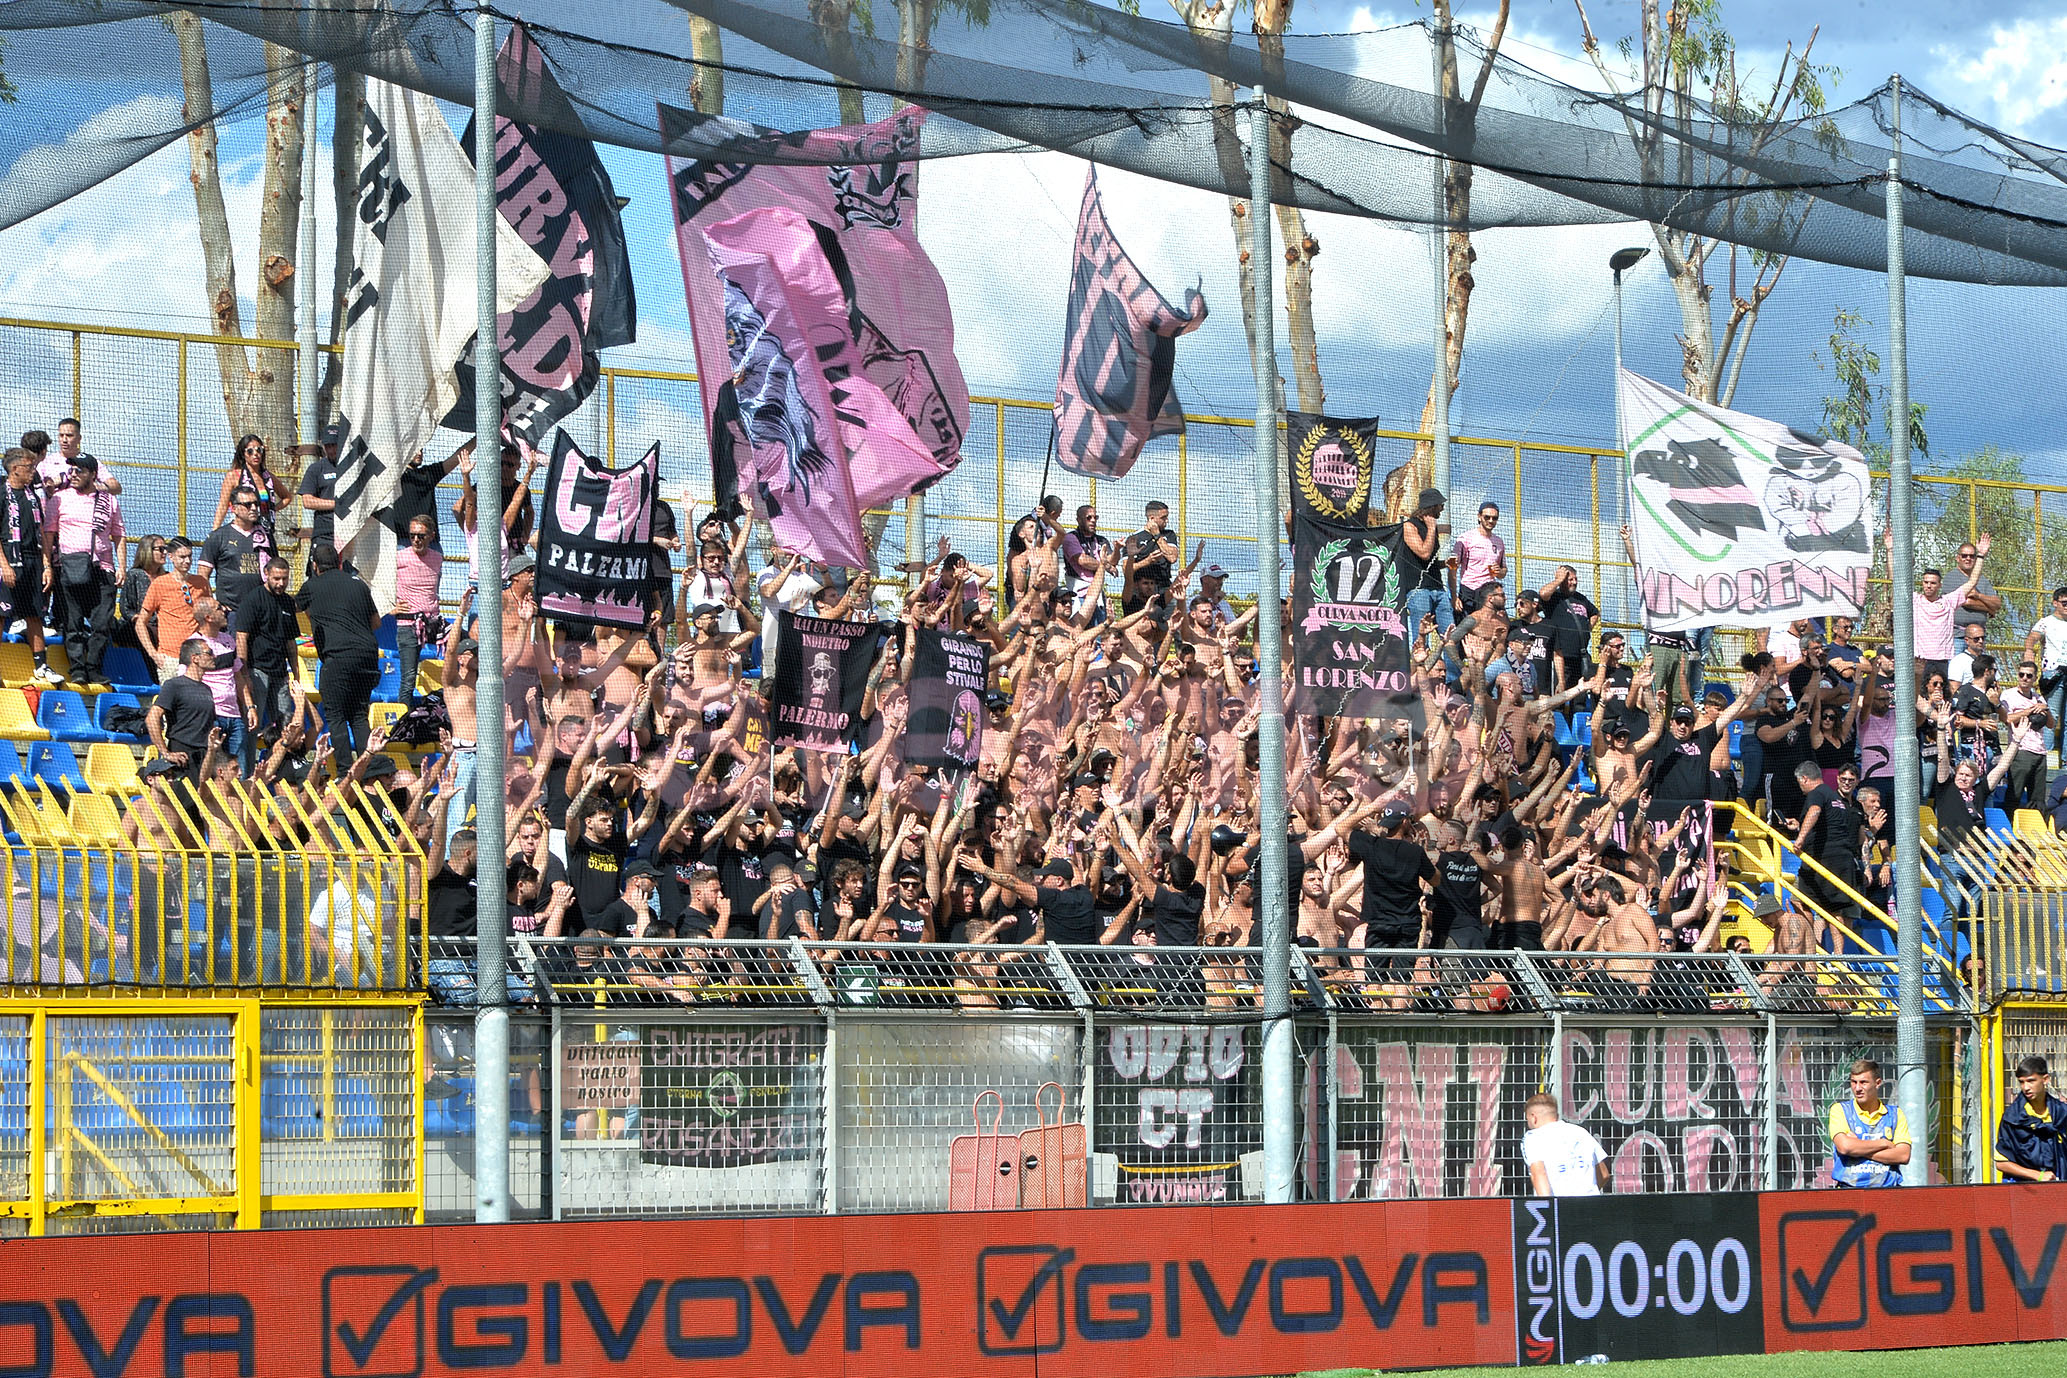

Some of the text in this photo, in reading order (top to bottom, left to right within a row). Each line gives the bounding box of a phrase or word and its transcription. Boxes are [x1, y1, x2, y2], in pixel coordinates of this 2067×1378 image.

[240, 560, 259, 568] WILD
[240, 566, 260, 574] WEST
[241, 553, 257, 561] OLD
[549, 543, 648, 580] PALERMO
[1336, 555, 1381, 603] 12
[1635, 559, 1870, 616] MINORENNI
[793, 616, 866, 637] MAI UN PASSO
[1318, 606, 1393, 622] CURVA NORD
[802, 634, 850, 651] INDIETRO
[941, 637, 983, 659] GIRANDO
[1332, 640, 1375, 662] SAN
[949, 655, 982, 674] PER LO
[1303, 667, 1407, 691] LORENZO
[946, 671, 985, 690] STIVALE
[779, 704, 850, 730] PALERMO
[650, 1026, 800, 1068] EMIGRATI
[1109, 1026, 1245, 1081] ODIO
[1561, 1027, 1815, 1124] CURVA
[578, 1085, 631, 1099] nostro
[667, 1088, 703, 1099] ETERNA
[1140, 1088, 1214, 1149] CT
[642, 1115, 807, 1157] ROSANERO
[1595, 1122, 1803, 1193] ORD
[1525, 1200, 1553, 1342] NGM
[1563, 1238, 1751, 1319] 00:00
[1876, 1223, 2067, 1316] GIV
[1074, 1253, 1490, 1342] GIVOVA
[436, 1271, 921, 1369] GIVOVA
